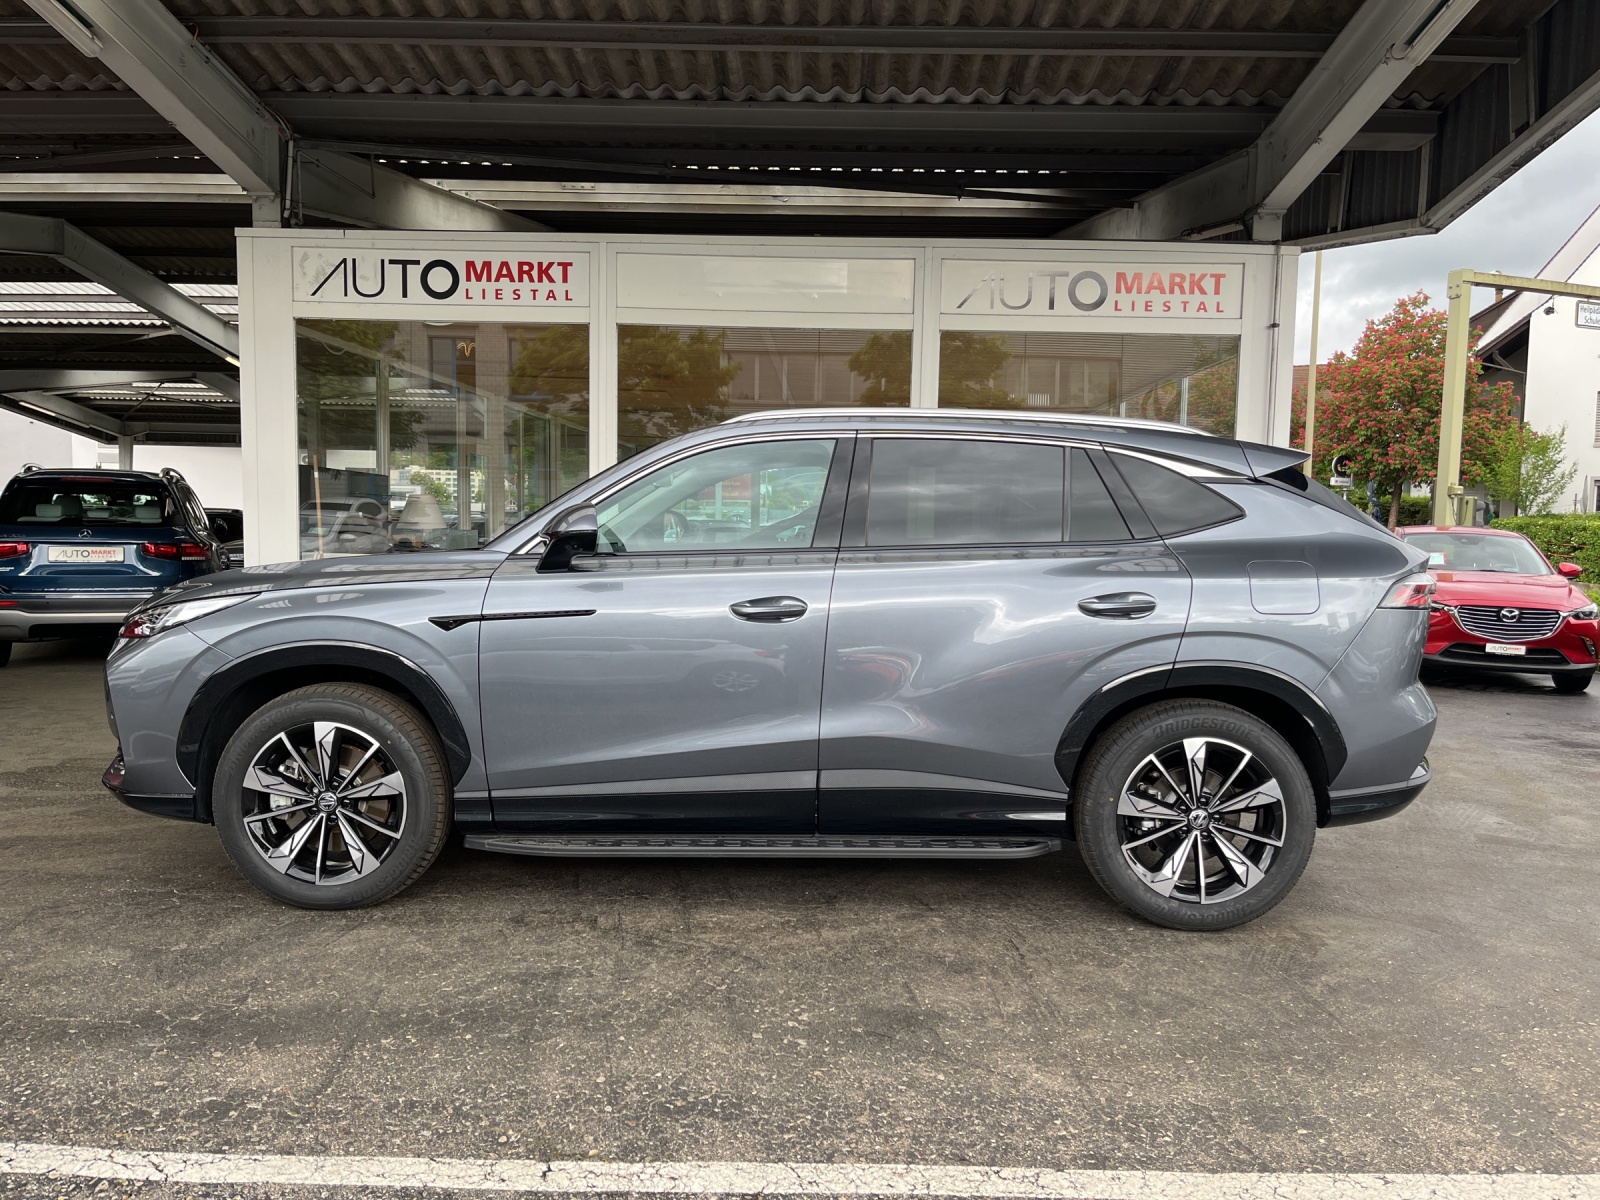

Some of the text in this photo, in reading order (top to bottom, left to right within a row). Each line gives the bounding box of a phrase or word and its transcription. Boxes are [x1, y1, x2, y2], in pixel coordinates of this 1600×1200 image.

[309, 257, 573, 300] AUTO MARKT
[465, 288, 573, 301] LIESTAL
[956, 270, 1226, 312] AUTO MARKT
[1114, 299, 1225, 313] LIESTAL
[56, 549, 90, 558] AUTO
[1152, 717, 1255, 740] BRIDGESTONE
